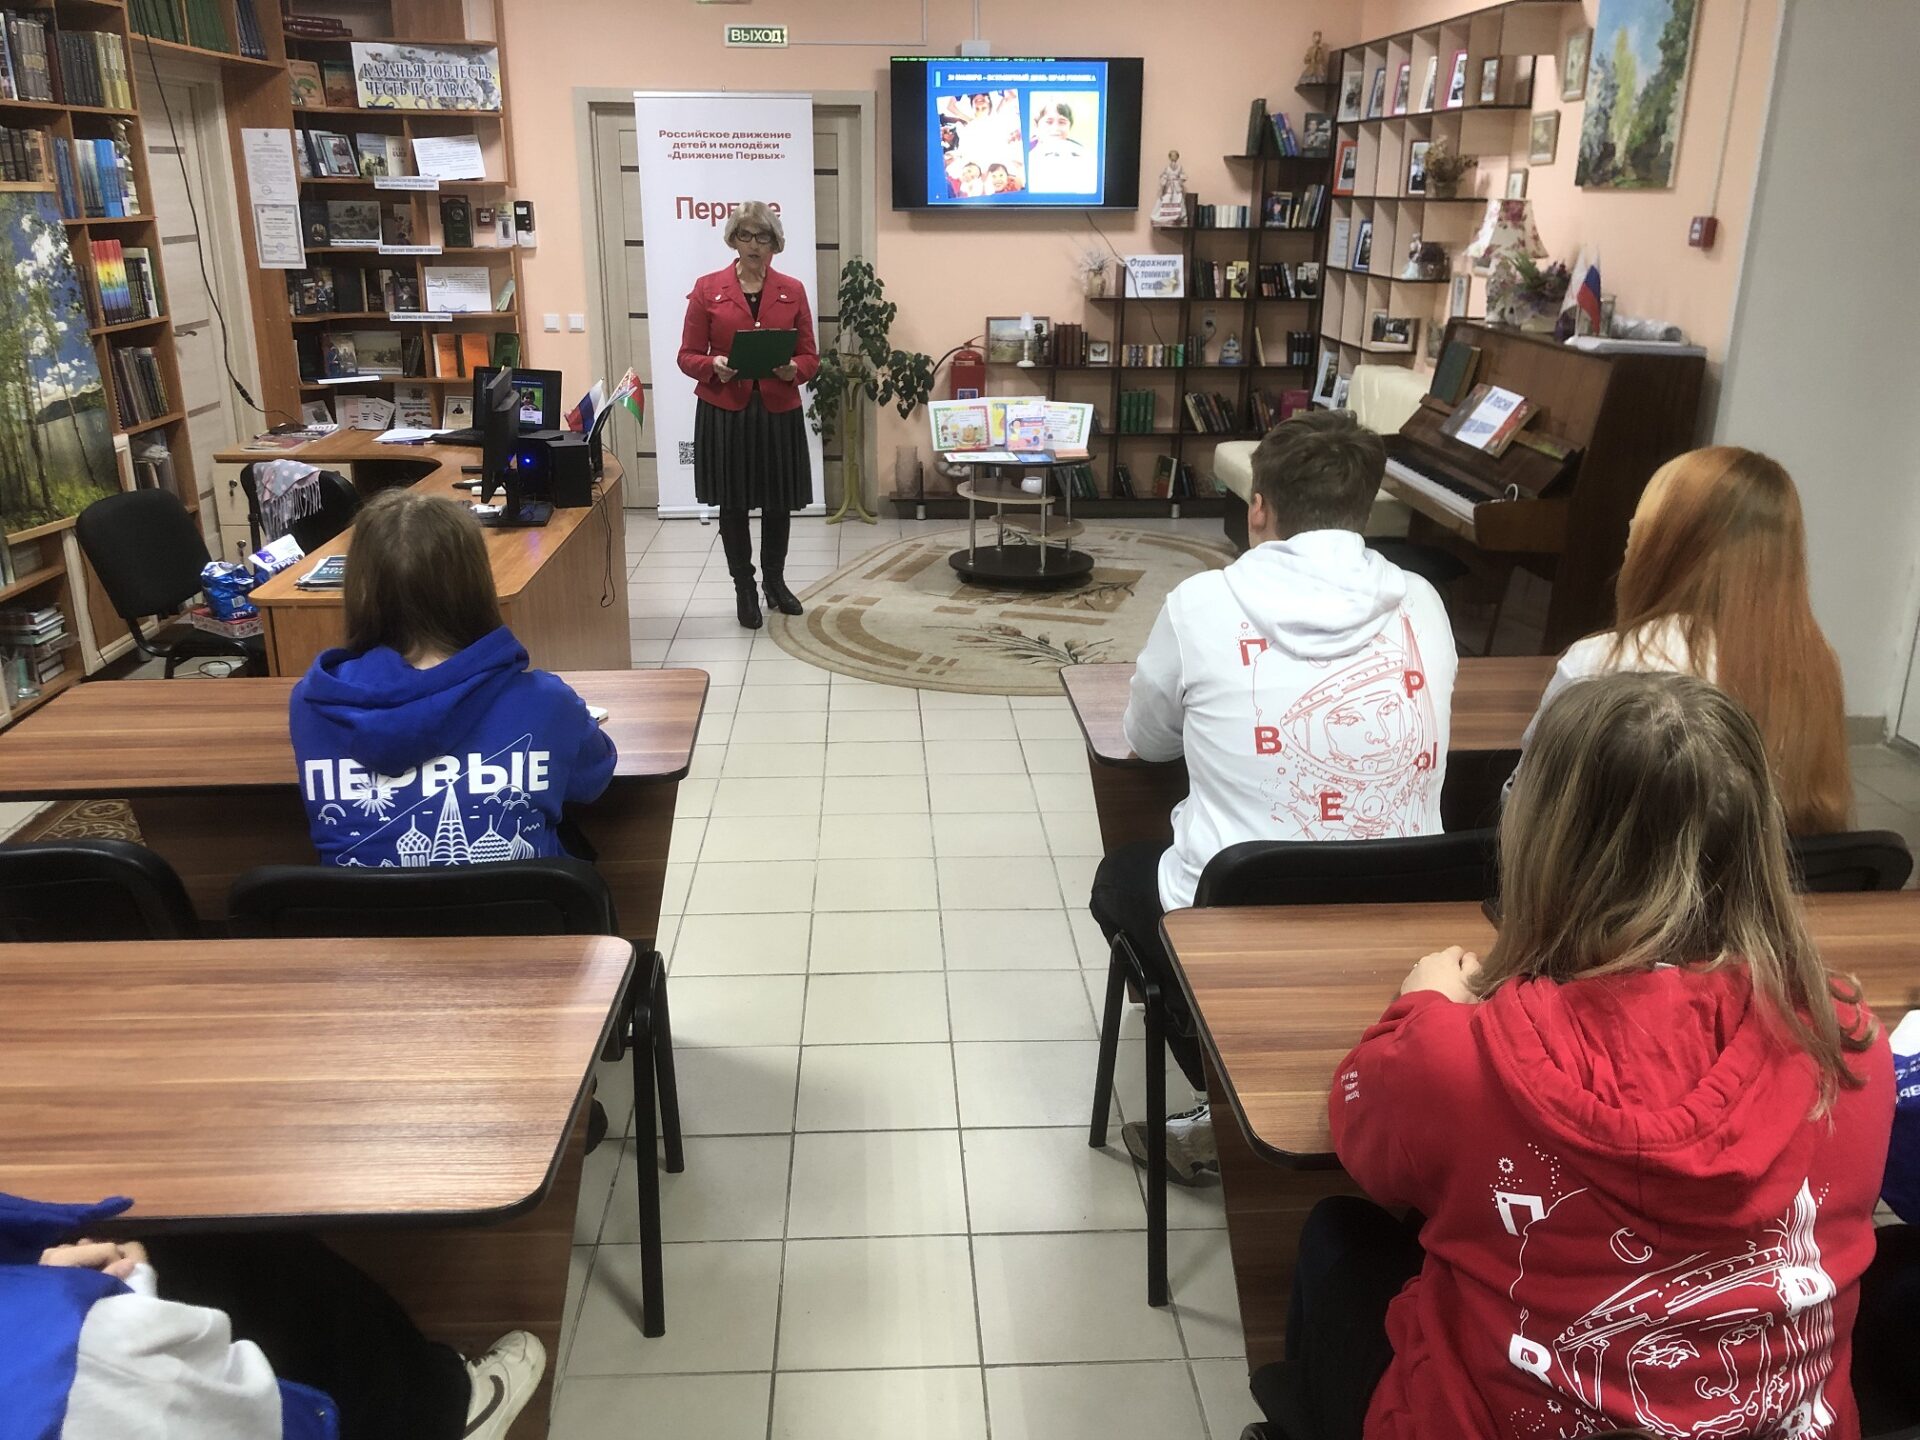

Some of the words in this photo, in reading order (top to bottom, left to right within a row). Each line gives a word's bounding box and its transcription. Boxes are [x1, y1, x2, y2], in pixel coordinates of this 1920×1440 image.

[731, 29, 782, 43] ВЫХОД
[362, 63, 422, 78] КАЗАЧЬЯ
[365, 81, 407, 96] ЧЕСТЬ
[411, 82, 420, 96] И
[423, 82, 470, 97] СЛАВА!
[659, 129, 730, 139] Российское
[732, 131, 792, 140] движение
[672, 141, 707, 150] детей
[719, 141, 780, 150] молодёжи
[667, 151, 734, 160] «Движение
[735, 152, 786, 161] Первых»
[676, 196, 781, 227] Перве
[1129, 258, 1177, 268] Отдохните
[1403, 671, 1425, 698] Р
[1254, 726, 1283, 755] В
[1320, 792, 1344, 822] Е
